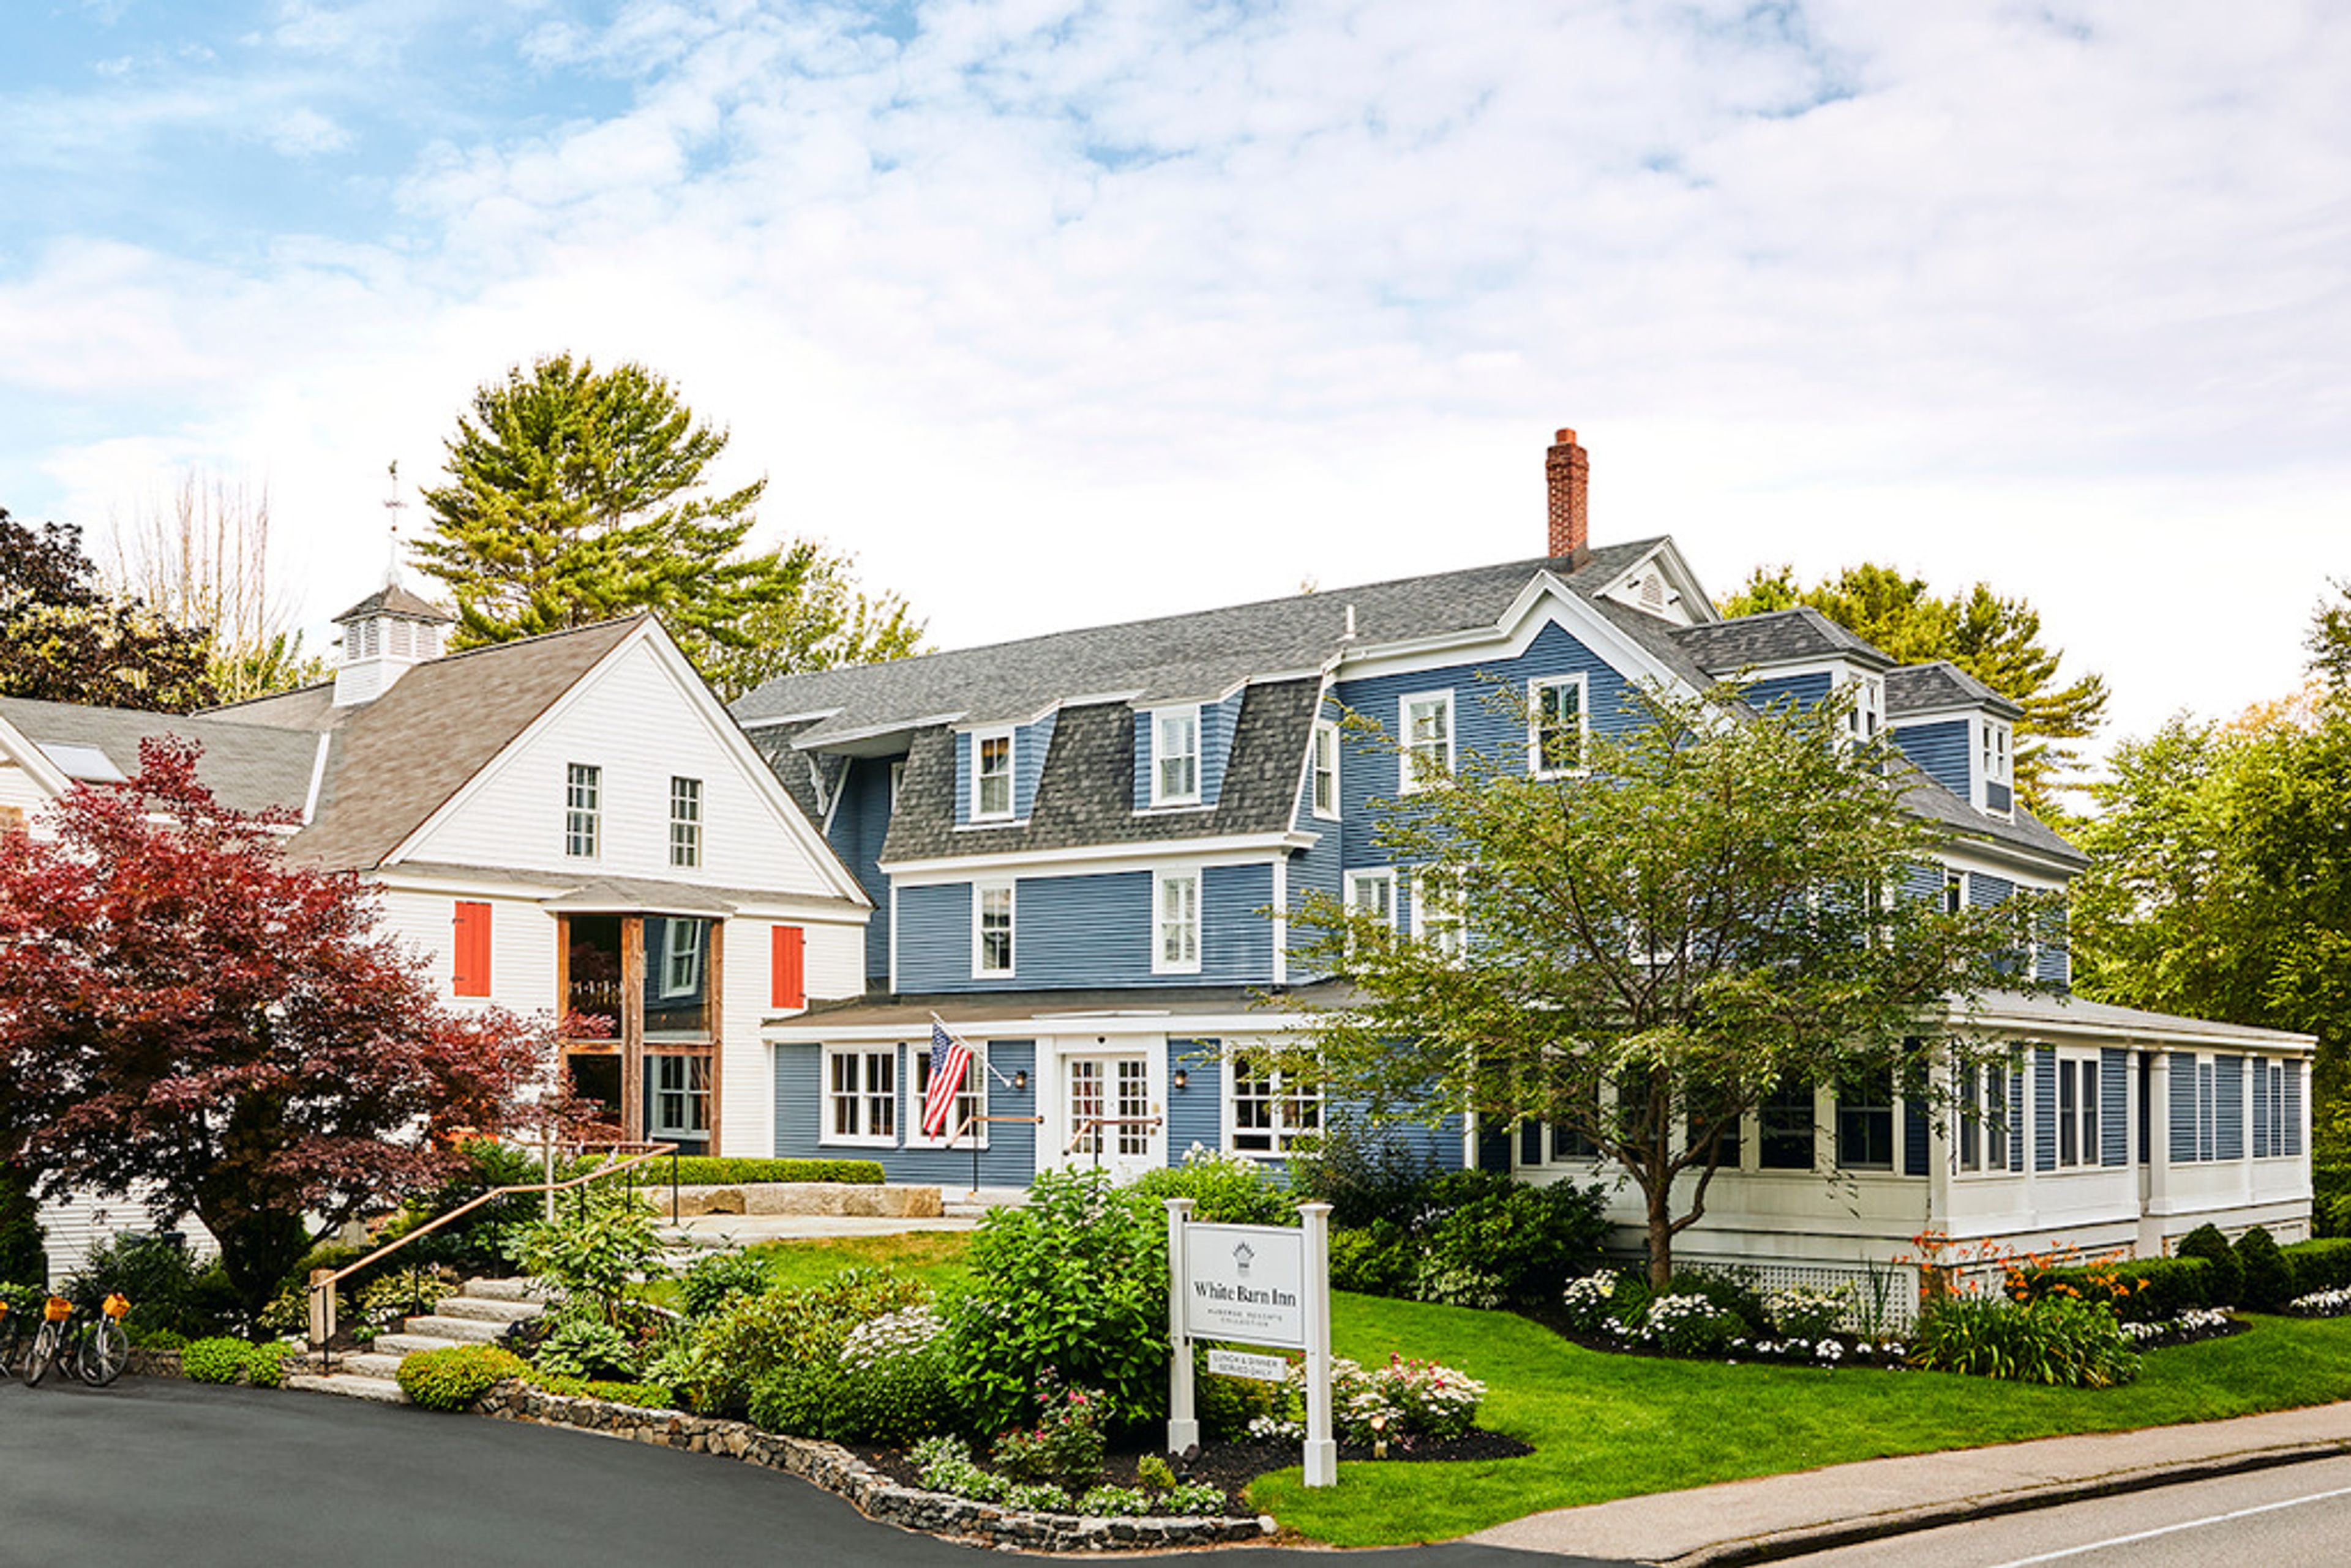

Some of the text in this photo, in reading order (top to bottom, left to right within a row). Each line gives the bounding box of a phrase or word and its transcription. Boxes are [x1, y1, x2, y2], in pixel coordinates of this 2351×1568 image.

[1194, 1281, 1296, 1307] White Barn Inn
[1248, 1356, 1278, 1367] DINNER
